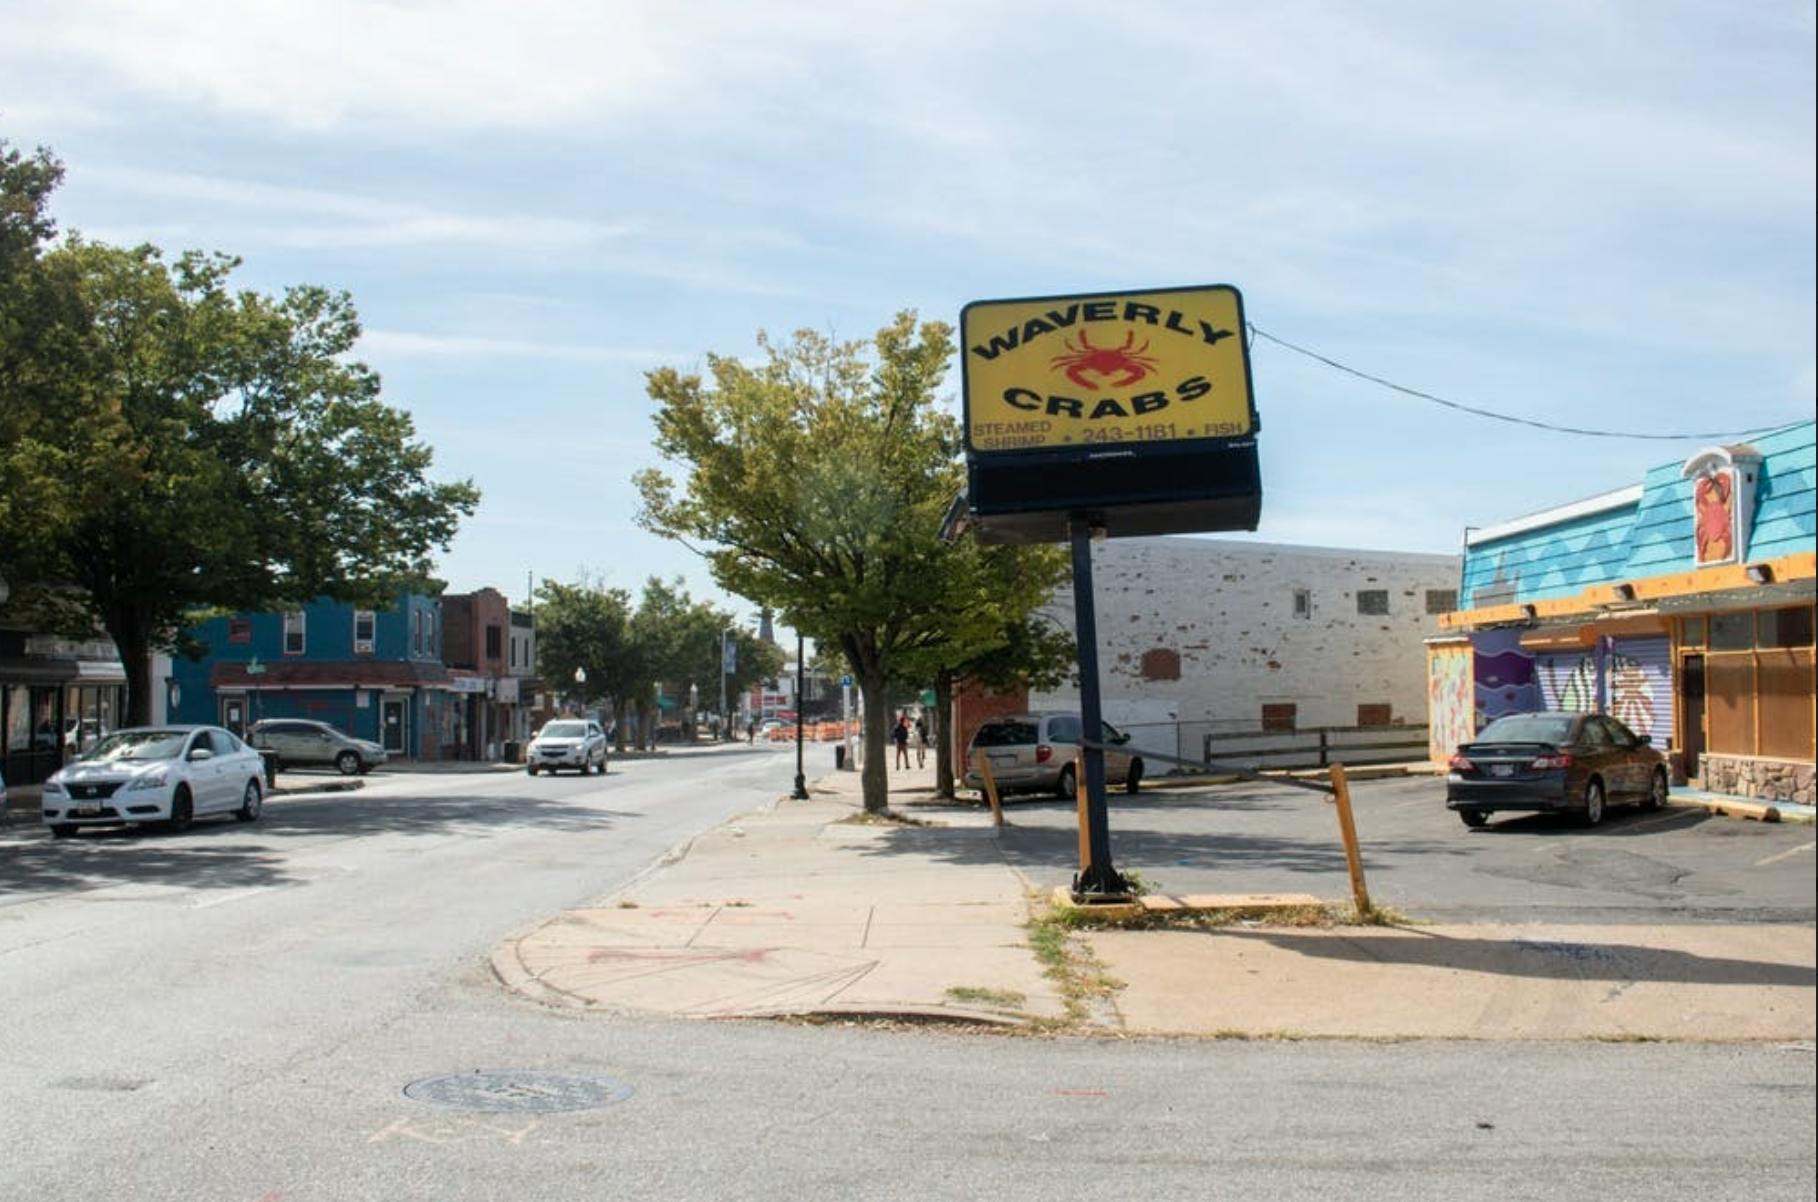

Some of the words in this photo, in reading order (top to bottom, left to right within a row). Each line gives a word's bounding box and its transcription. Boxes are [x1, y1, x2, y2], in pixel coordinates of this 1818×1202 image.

[971, 300, 1235, 361] WAVERLY
[1003, 376, 1213, 419] CRABS
[973, 420, 1052, 437] STEAMED
[1082, 423, 1177, 443] 243-1181
[1204, 422, 1242, 436] FISH
[983, 435, 1046, 449] SHRIMP
